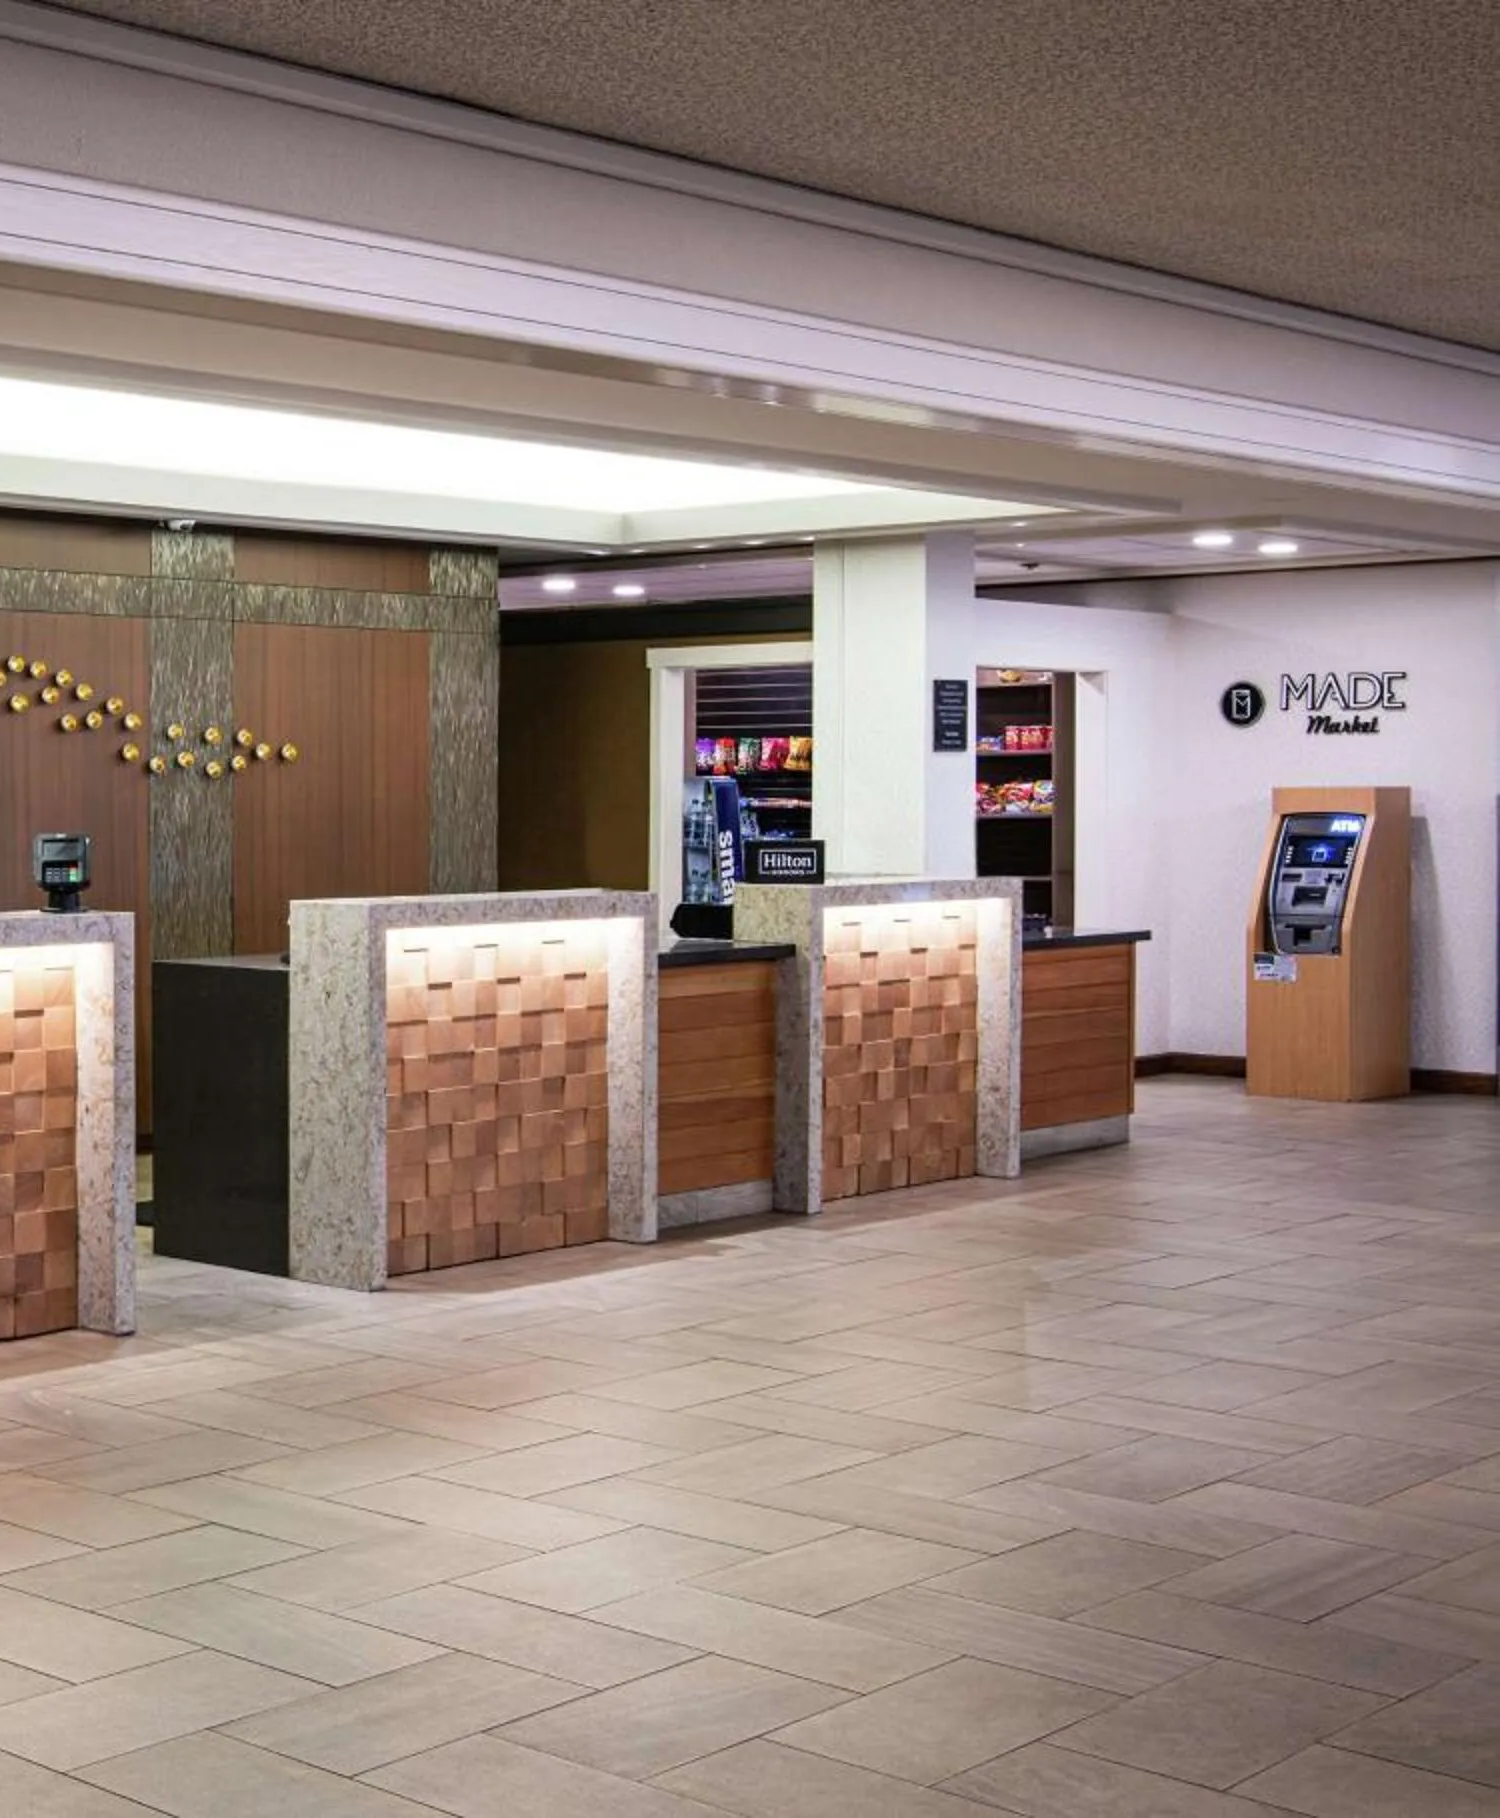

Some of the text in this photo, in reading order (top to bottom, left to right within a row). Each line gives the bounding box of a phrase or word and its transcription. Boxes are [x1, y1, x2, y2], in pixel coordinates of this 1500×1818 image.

[1280, 671, 1406, 711] MADE
[1306, 715, 1381, 735] Market
[1330, 819, 1362, 833] ATM
[763, 853, 812, 868] Hilton
